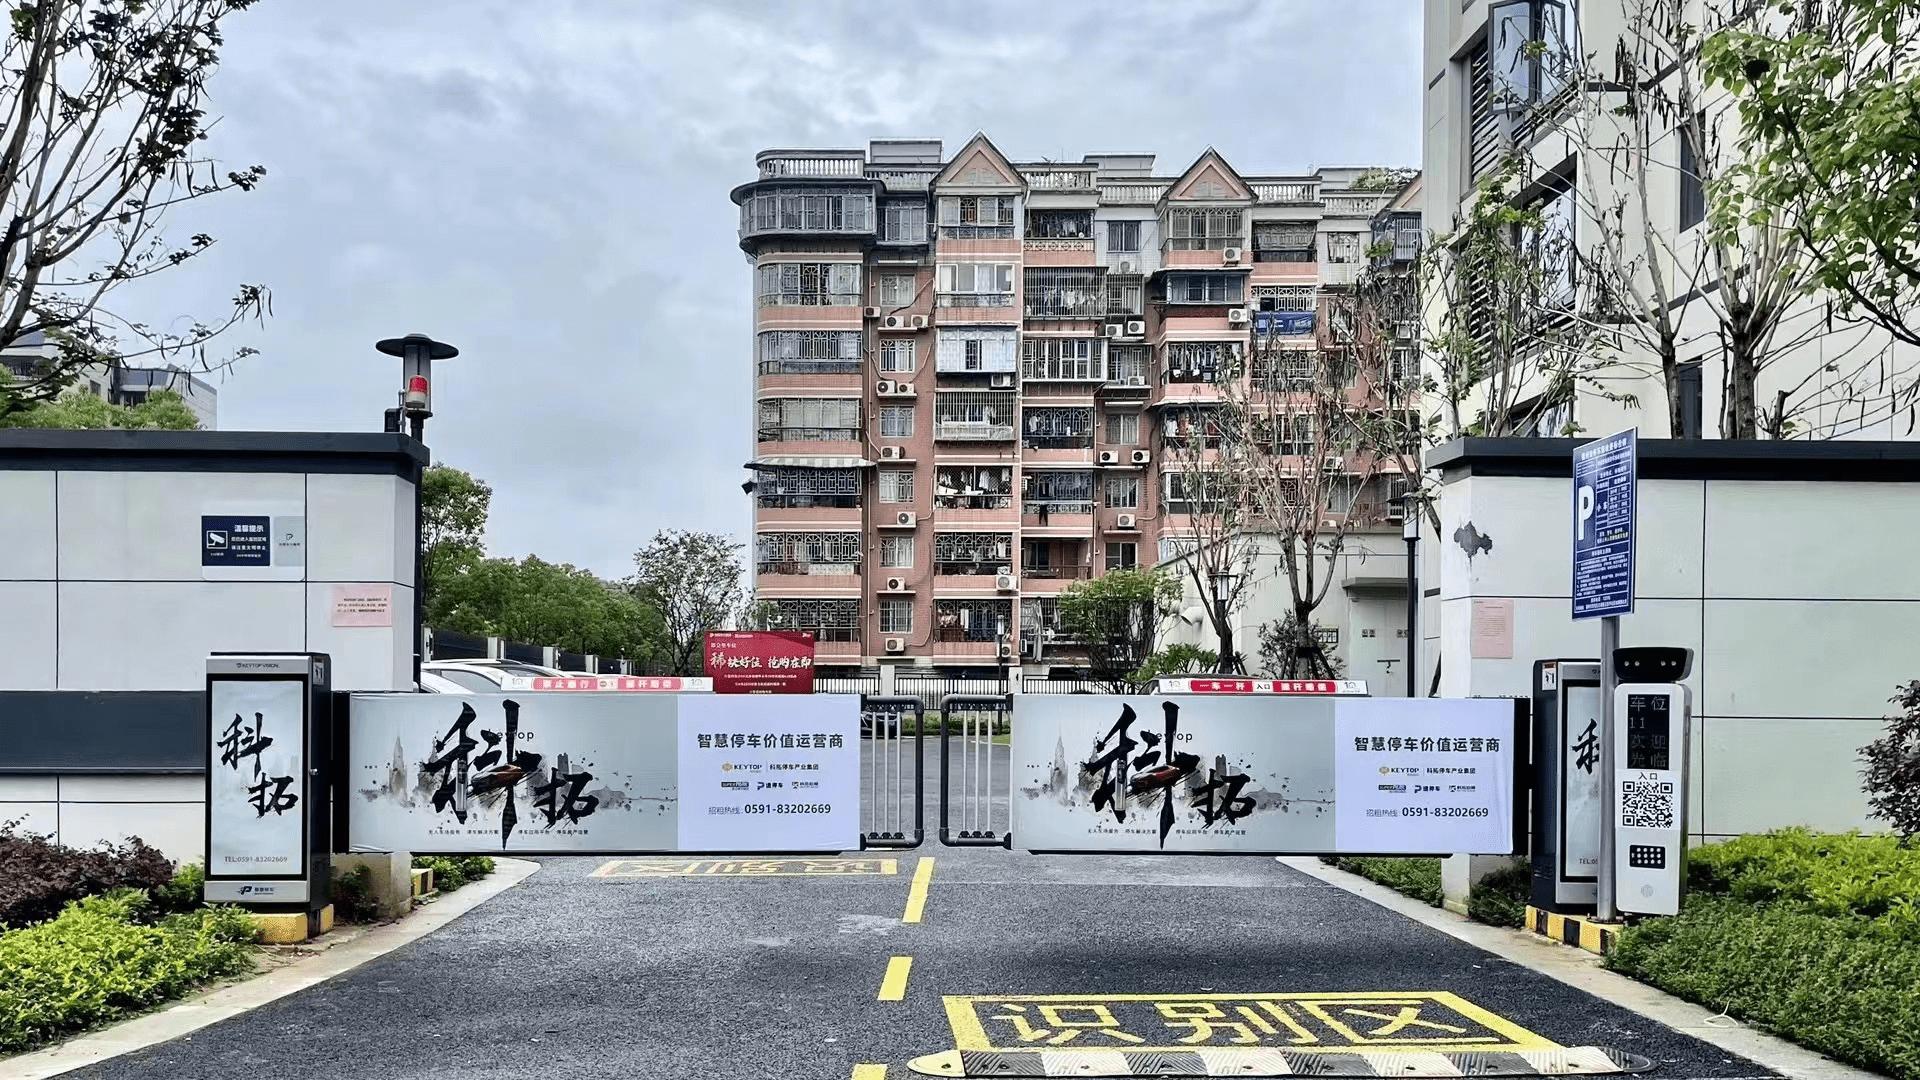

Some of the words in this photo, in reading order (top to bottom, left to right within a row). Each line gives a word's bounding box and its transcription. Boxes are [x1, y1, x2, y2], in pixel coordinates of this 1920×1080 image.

[1578, 485, 1594, 541] P
[1629, 695, 1667, 712] 车位
[1629, 717, 1645, 729] 11
[697, 733, 844, 749] 智慧停车价值运营商
[1354, 736, 1501, 752] 智慧停车价值运营商
[217, 712, 298, 819] 科拓
[421, 699, 599, 851] 科拓
[1081, 700, 1257, 850] 科拓
[1638, 772, 1658, 780] 入口
[744, 804, 831, 814] 0591-83202669
[1402, 807, 1489, 817] 0591-83202669
[992, 999, 1500, 1046] 识别区
